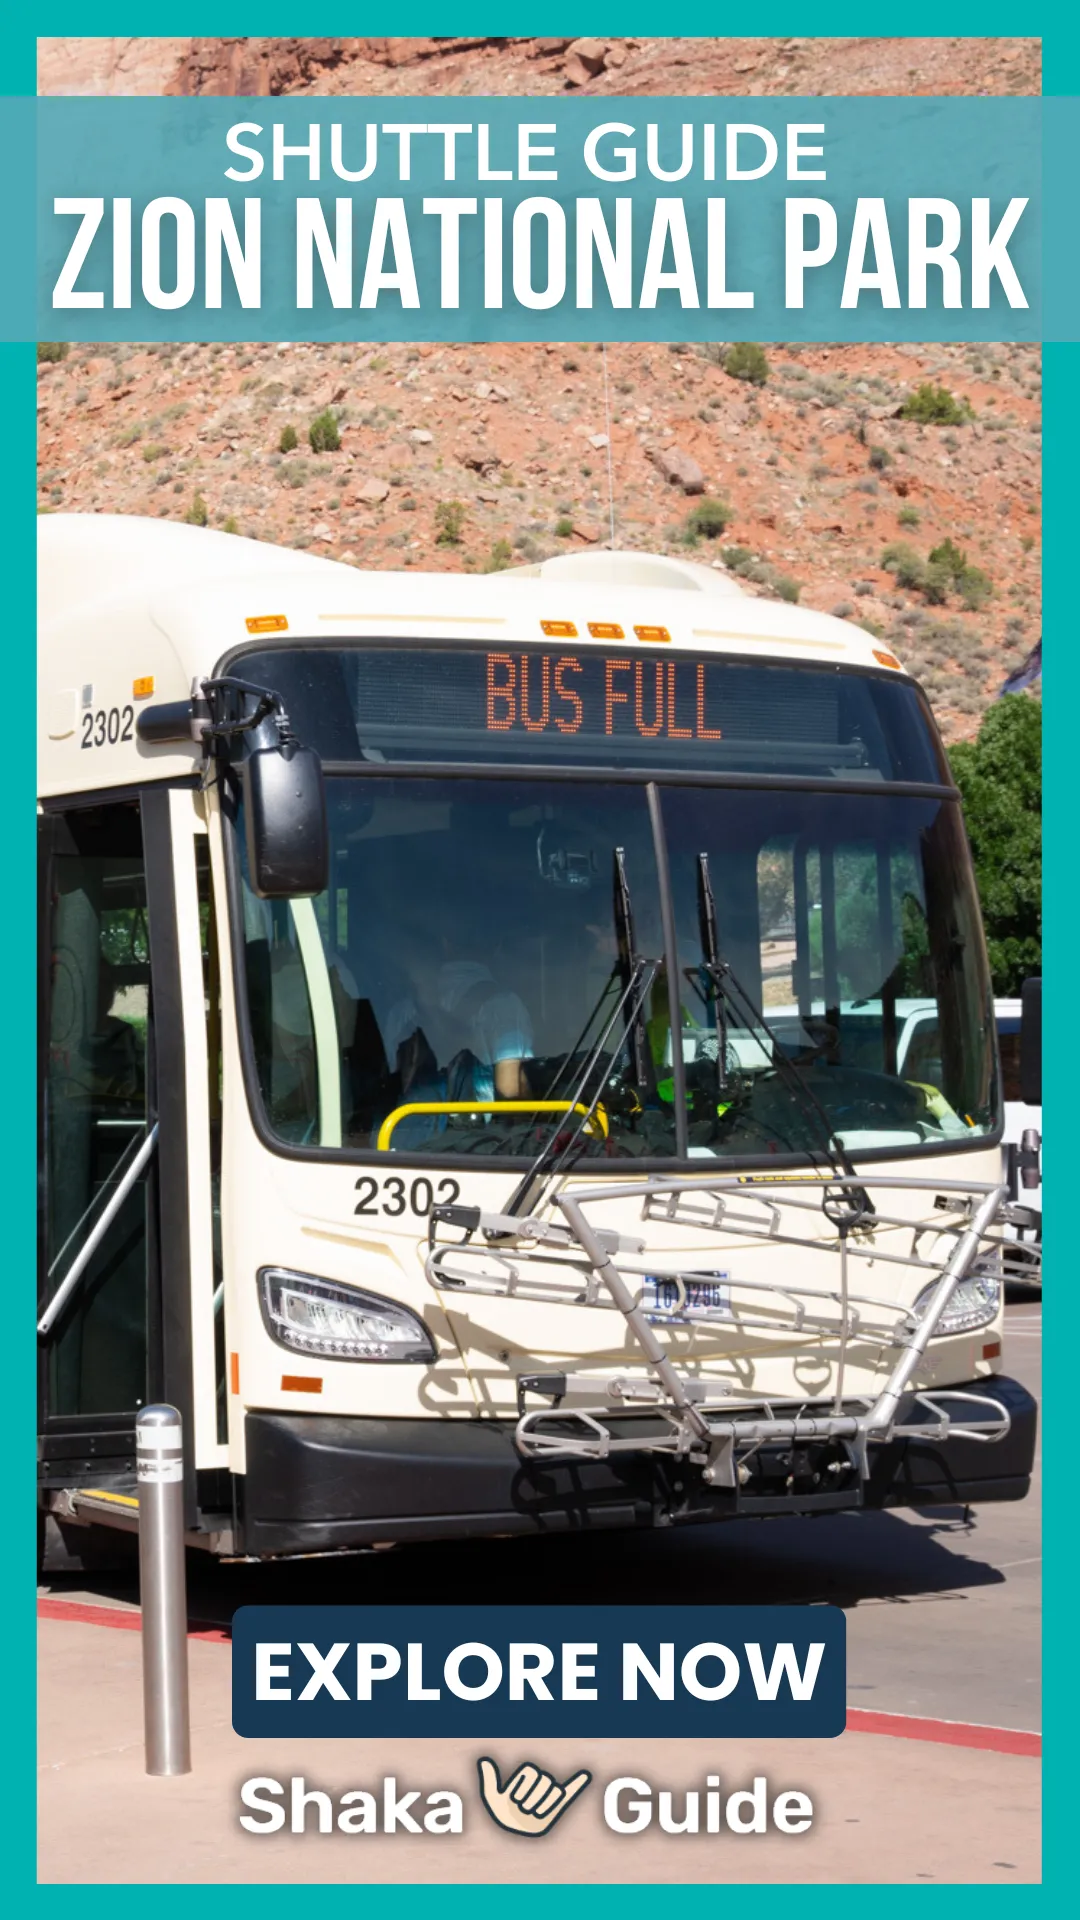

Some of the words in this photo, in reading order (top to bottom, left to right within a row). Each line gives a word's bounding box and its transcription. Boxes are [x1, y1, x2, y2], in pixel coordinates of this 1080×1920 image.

[487, 653, 583, 733] BUS
[605, 659, 721, 739] FULL
[81, 705, 134, 749] 2302
[354, 1176, 460, 1216] 2302
